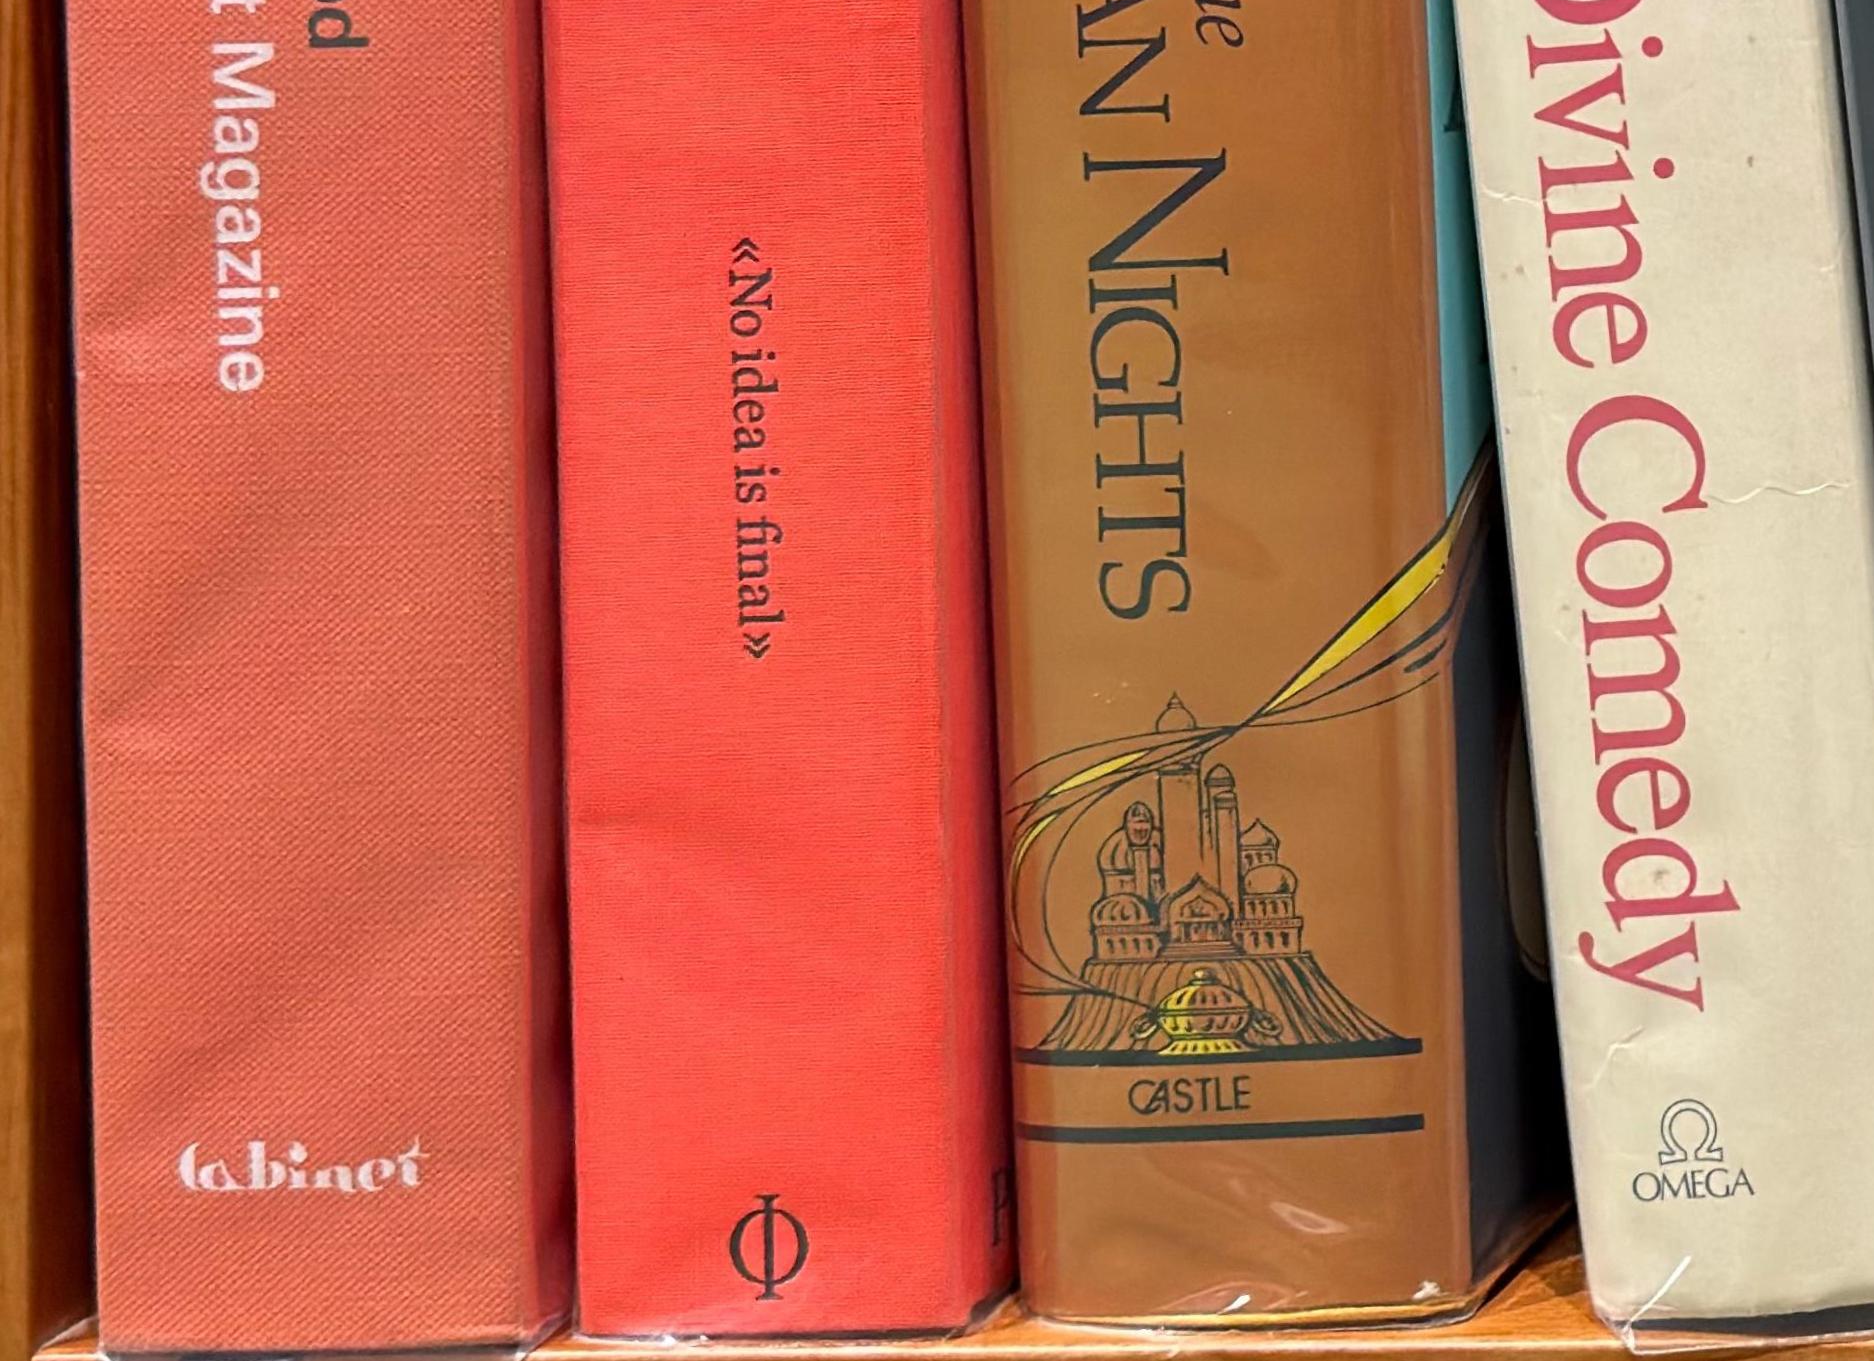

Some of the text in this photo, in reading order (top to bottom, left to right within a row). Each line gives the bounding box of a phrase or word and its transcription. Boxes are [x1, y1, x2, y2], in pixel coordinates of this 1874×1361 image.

[200, 43, 280, 392] Magazine
[731, 347, 779, 452] idea
[1082, 148, 1230, 620] NIGHTS
[734, 464, 781, 505] is
[1566, 394, 1741, 1011] Comedy
[1128, 1075, 1251, 1115] CASTLE
[177, 1135, 429, 1194] Cabinet
[1632, 1168, 1756, 1202] OMEGA
